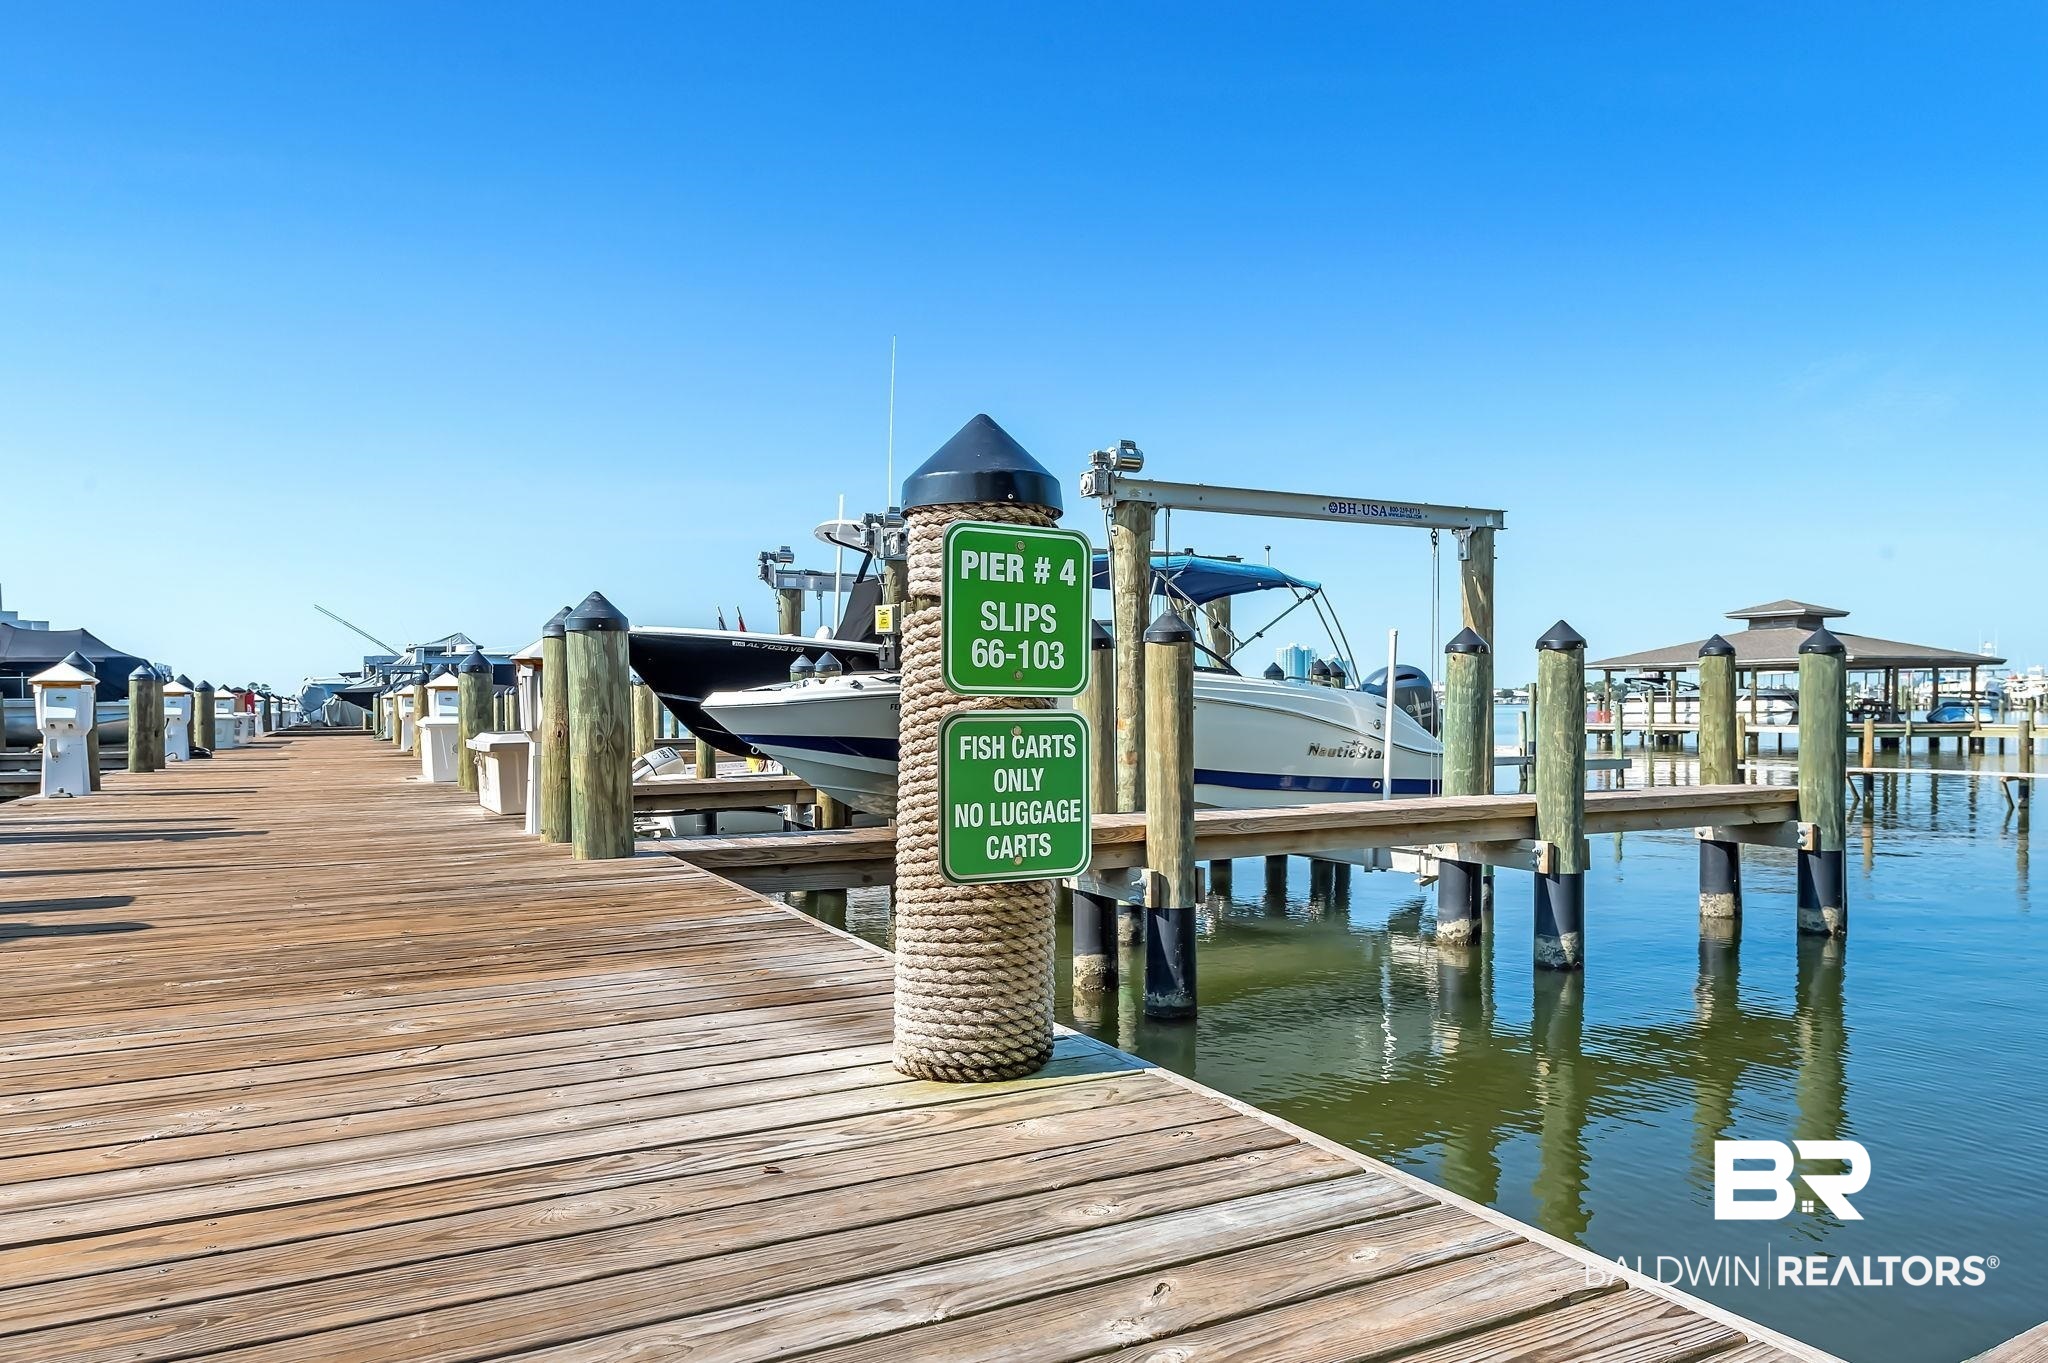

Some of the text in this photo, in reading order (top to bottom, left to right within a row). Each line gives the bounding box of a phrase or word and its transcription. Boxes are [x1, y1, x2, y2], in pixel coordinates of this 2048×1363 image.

[1338, 502, 1387, 517] BH-USA
[960, 549, 1076, 586] PIER # 4
[980, 600, 1057, 634] SLIPS
[971, 638, 1065, 670] 66-103
[959, 734, 1077, 760] FISH CARTS
[993, 767, 1045, 793] ONLY
[954, 799, 1082, 828] NO LUGGAGE
[986, 832, 1052, 860] CARTS
